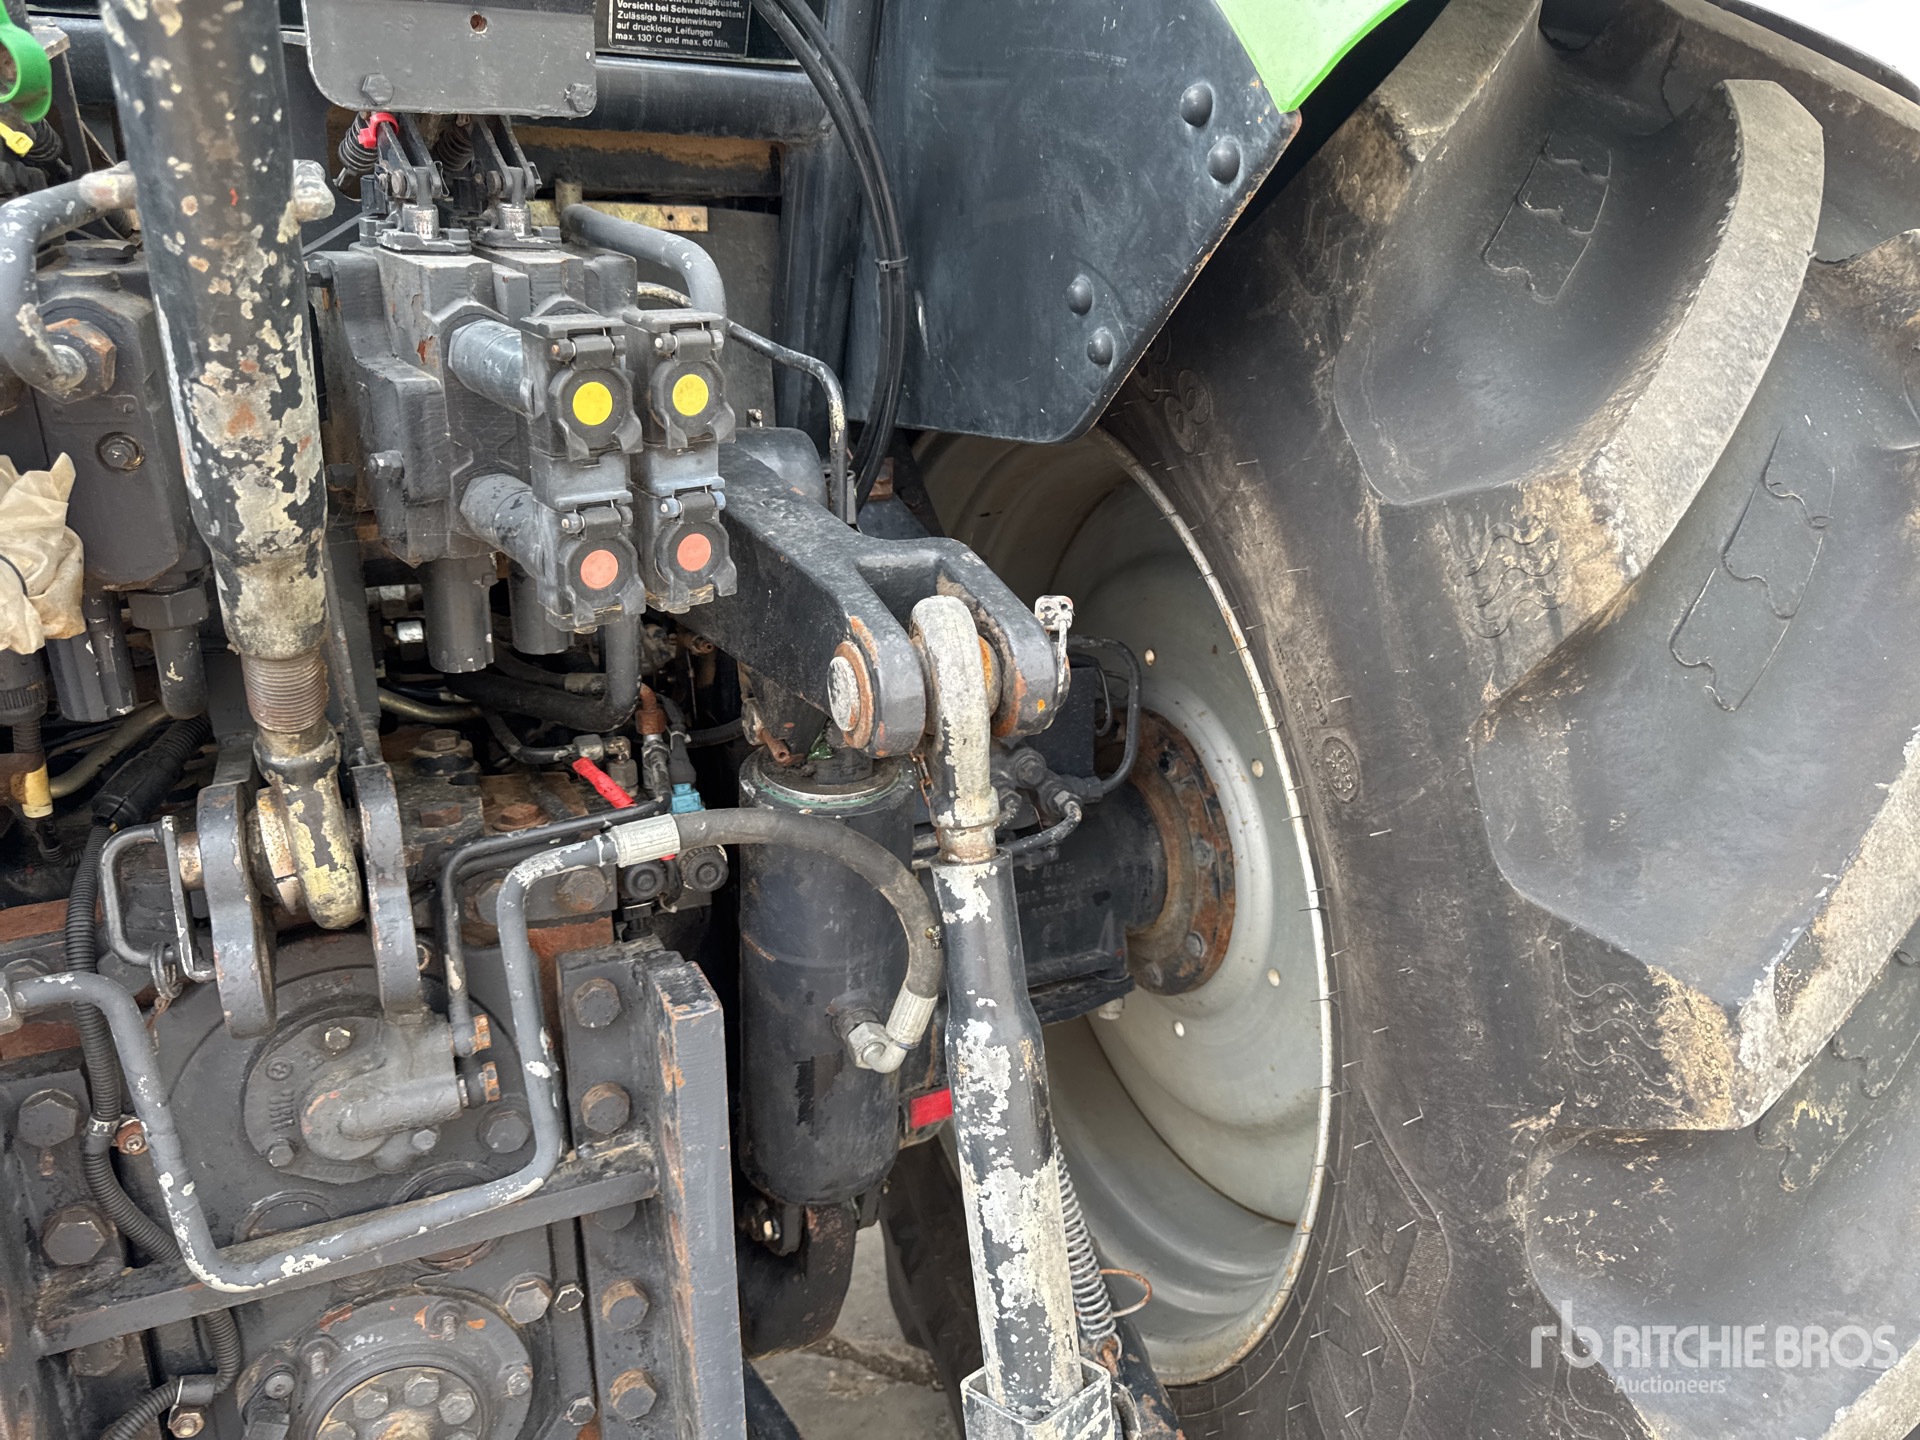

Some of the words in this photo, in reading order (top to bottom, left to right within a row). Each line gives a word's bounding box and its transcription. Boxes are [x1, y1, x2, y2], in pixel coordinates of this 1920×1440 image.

[617, 0, 654, 11] Vorsicht
[655, 3, 669, 12] bei
[671, 5, 745, 19] Schweißarbeiten!
[617, 11, 657, 22] Zulässige
[660, 14, 722, 28] Hitzeeinwirkung
[616, 22, 630, 30] auf
[632, 23, 672, 33] drucklose
[675, 27, 714, 37] Leitungen
[615, 33, 635, 41] max.
[664, 36, 680, 45] und
[681, 38, 701, 46] max.
[702, 38, 713, 47] 60
[714, 40, 730, 49] Min.
